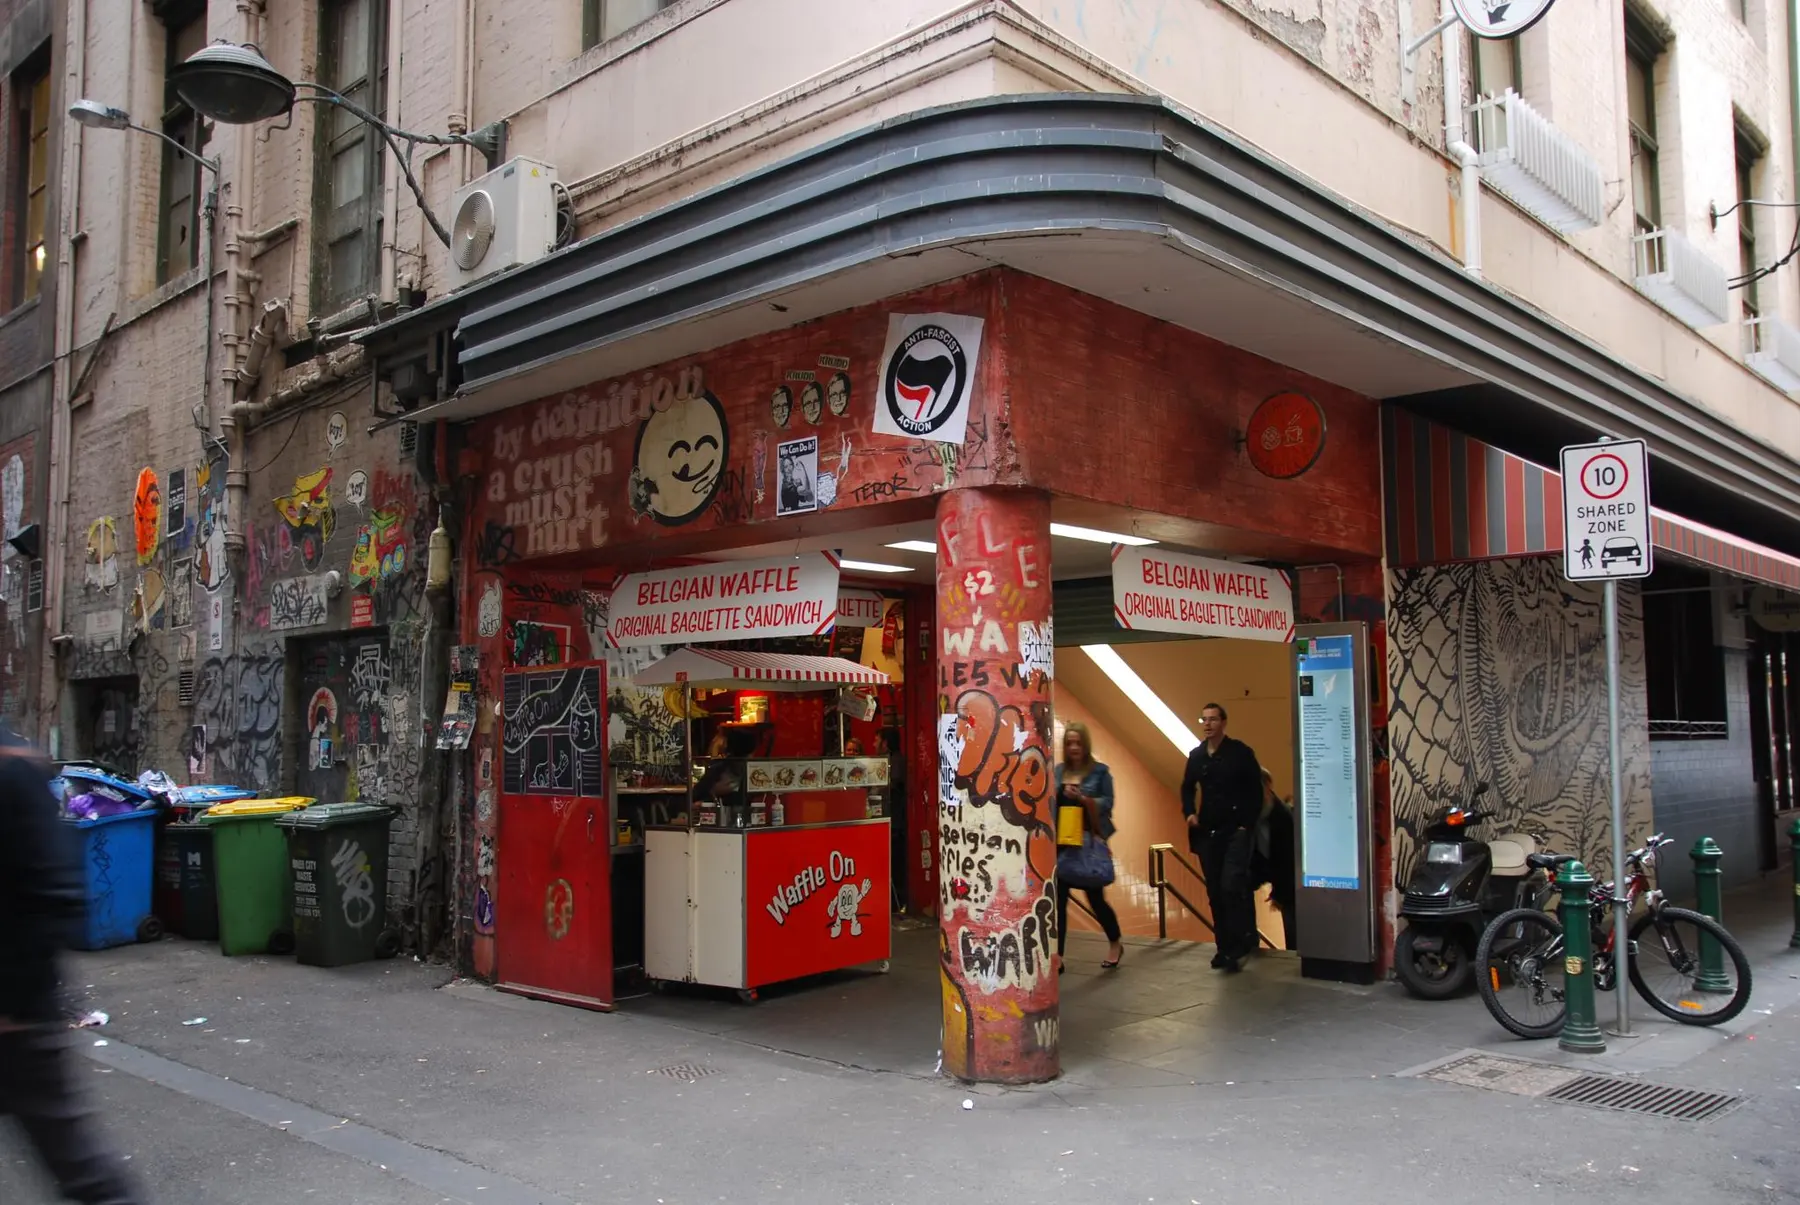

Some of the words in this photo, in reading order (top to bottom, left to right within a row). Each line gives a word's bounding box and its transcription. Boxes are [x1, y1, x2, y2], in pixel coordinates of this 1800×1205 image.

[904, 328, 960, 355] ANTI-FASCIST
[493, 423, 525, 462] by
[531, 364, 705, 447] definition
[897, 415, 932, 432] ACTION
[780, 445, 788, 455] We
[788, 443, 799, 454] Can
[799, 441, 807, 451] Do
[807, 439, 815, 450] It!
[487, 469, 506, 502] a
[513, 440, 613, 492] crush
[1595, 467, 1616, 487] 10
[505, 480, 594, 526] must
[1577, 503, 1636, 519] SHARED
[527, 502, 609, 554] hurt
[1588, 520, 1626, 534] ZONE
[637, 575, 715, 606] BELGIAN
[720, 566, 800, 599] WAFFLE
[963, 570, 997, 604] $2
[1142, 558, 1210, 591] BELGIAN
[1213, 572, 1269, 600] WAFFLE
[615, 612, 668, 639] ORIGINAL
[670, 607, 740, 633] BAGUETTE
[744, 600, 823, 628] SANDWICH
[837, 597, 880, 619] UETTE
[1124, 592, 1177, 620] ORIGINAL
[1180, 598, 1235, 626] BAGUETTE
[1237, 606, 1288, 631] SANDWICH
[766, 866, 826, 925] Waffle
[829, 850, 855, 882] On
[1309, 877, 1353, 889] melbourne
